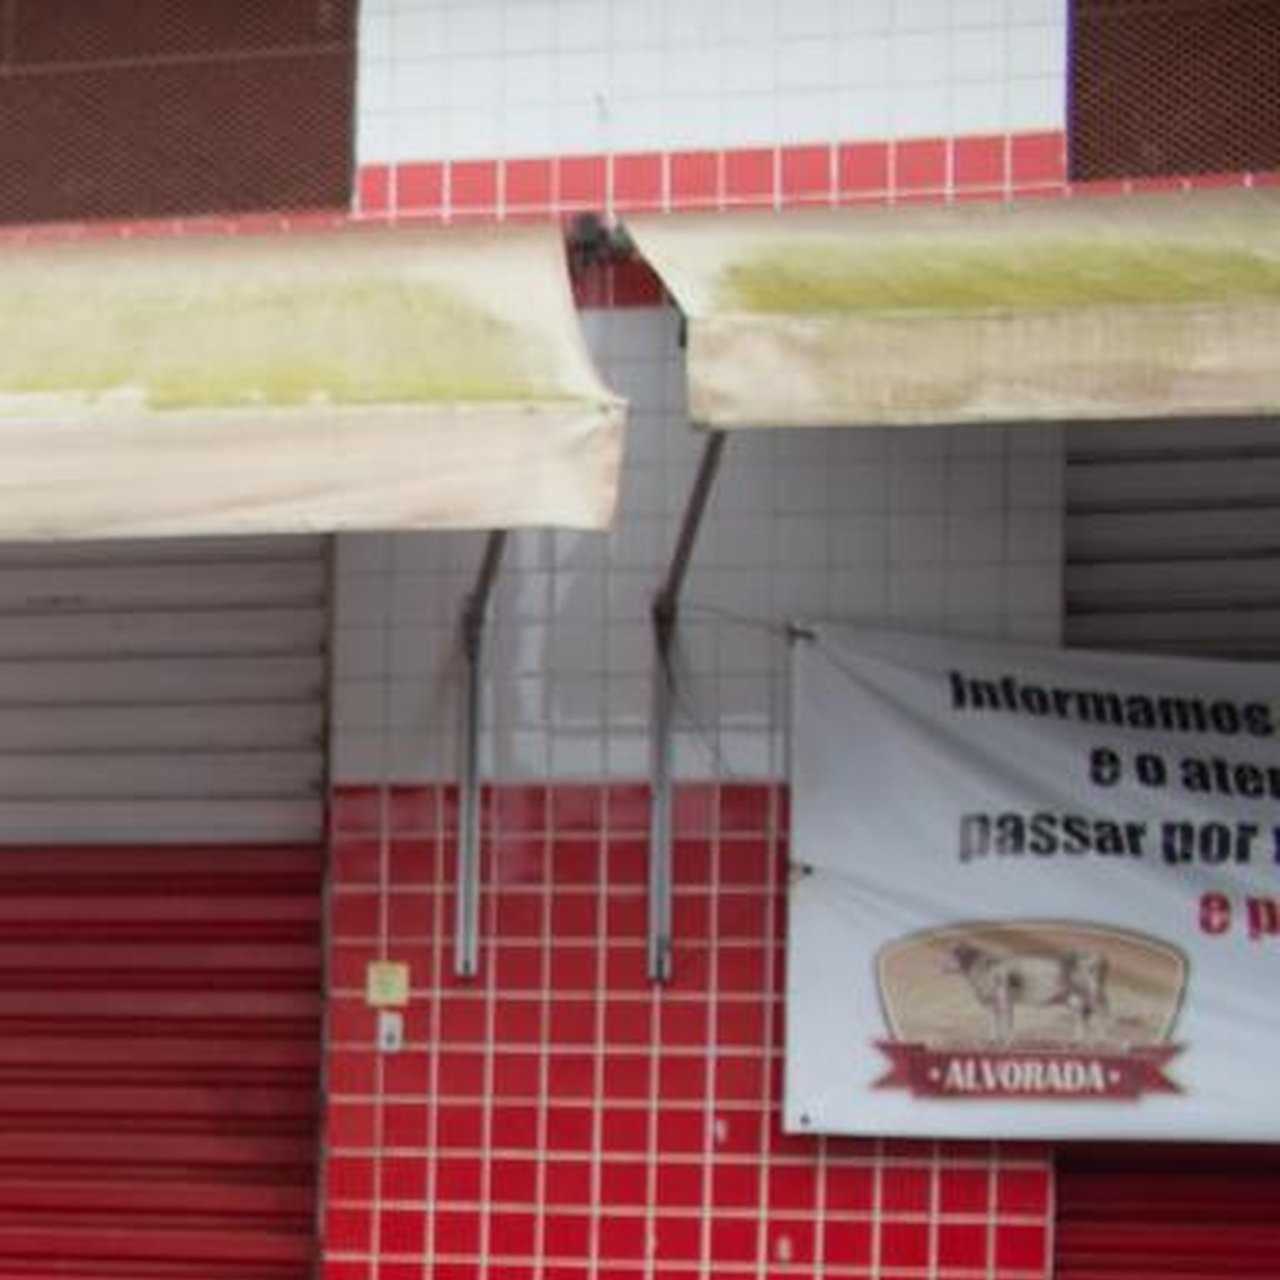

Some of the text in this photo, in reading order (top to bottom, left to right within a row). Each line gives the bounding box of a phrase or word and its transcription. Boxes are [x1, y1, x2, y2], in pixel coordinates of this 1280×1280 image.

[948, 669, 1274, 737] Informamos
[1090, 746, 1121, 787] e
[1135, 752, 1167, 787] o
[958, 811, 1147, 864] passar
[1161, 816, 1259, 866] por
[1197, 891, 1232, 936] e
[943, 1057, 1106, 1092] ALVORADA
